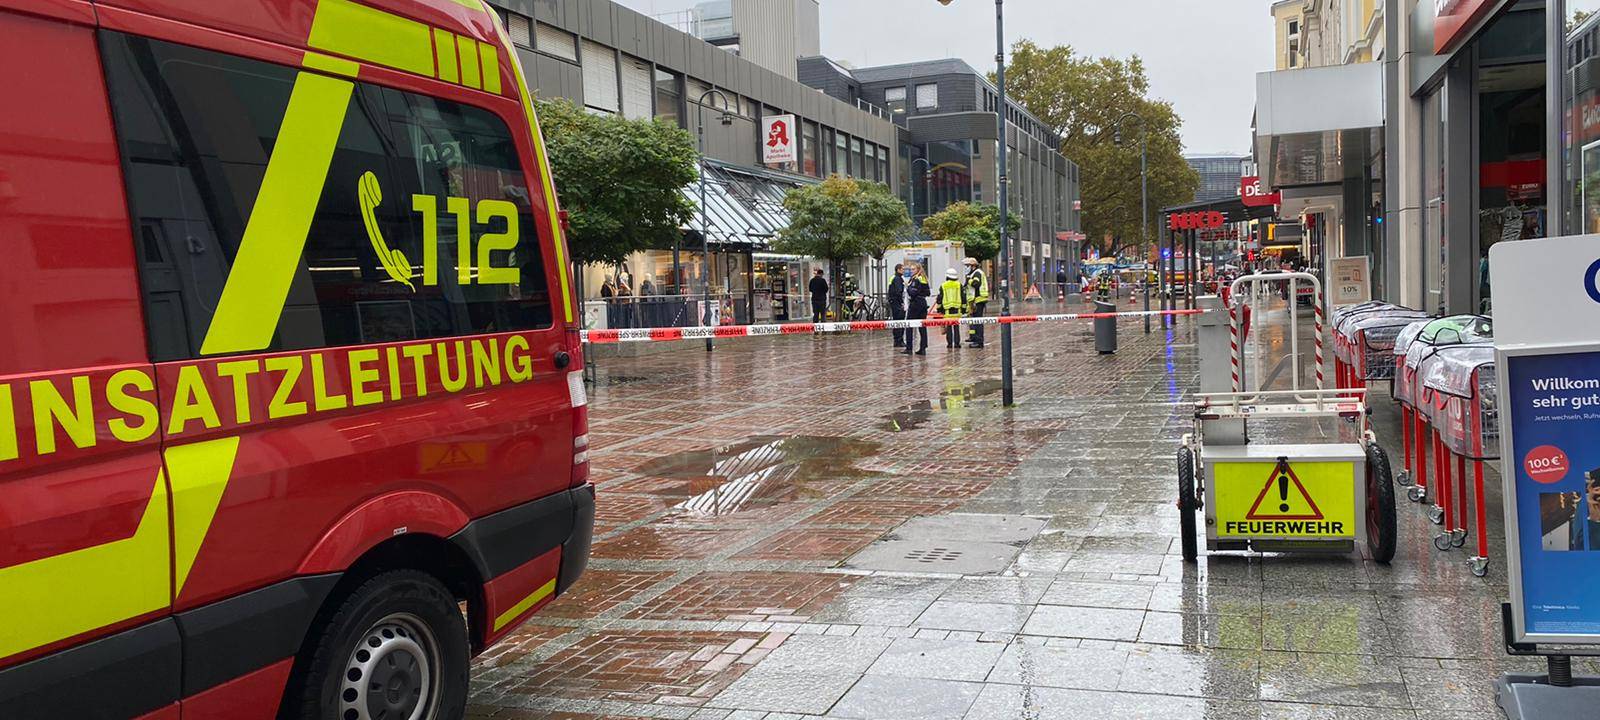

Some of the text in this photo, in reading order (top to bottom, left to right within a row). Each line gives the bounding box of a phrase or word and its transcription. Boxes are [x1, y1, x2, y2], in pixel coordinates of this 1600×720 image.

[1170, 210, 1225, 231] NKD
[411, 193, 521, 286] 112
[0, 335, 533, 461] INSATZLEITUNG
[1533, 393, 1600, 410] sehr gut
[1528, 457, 1551, 469] 100
[1225, 521, 1344, 534] FEUERWEHR
